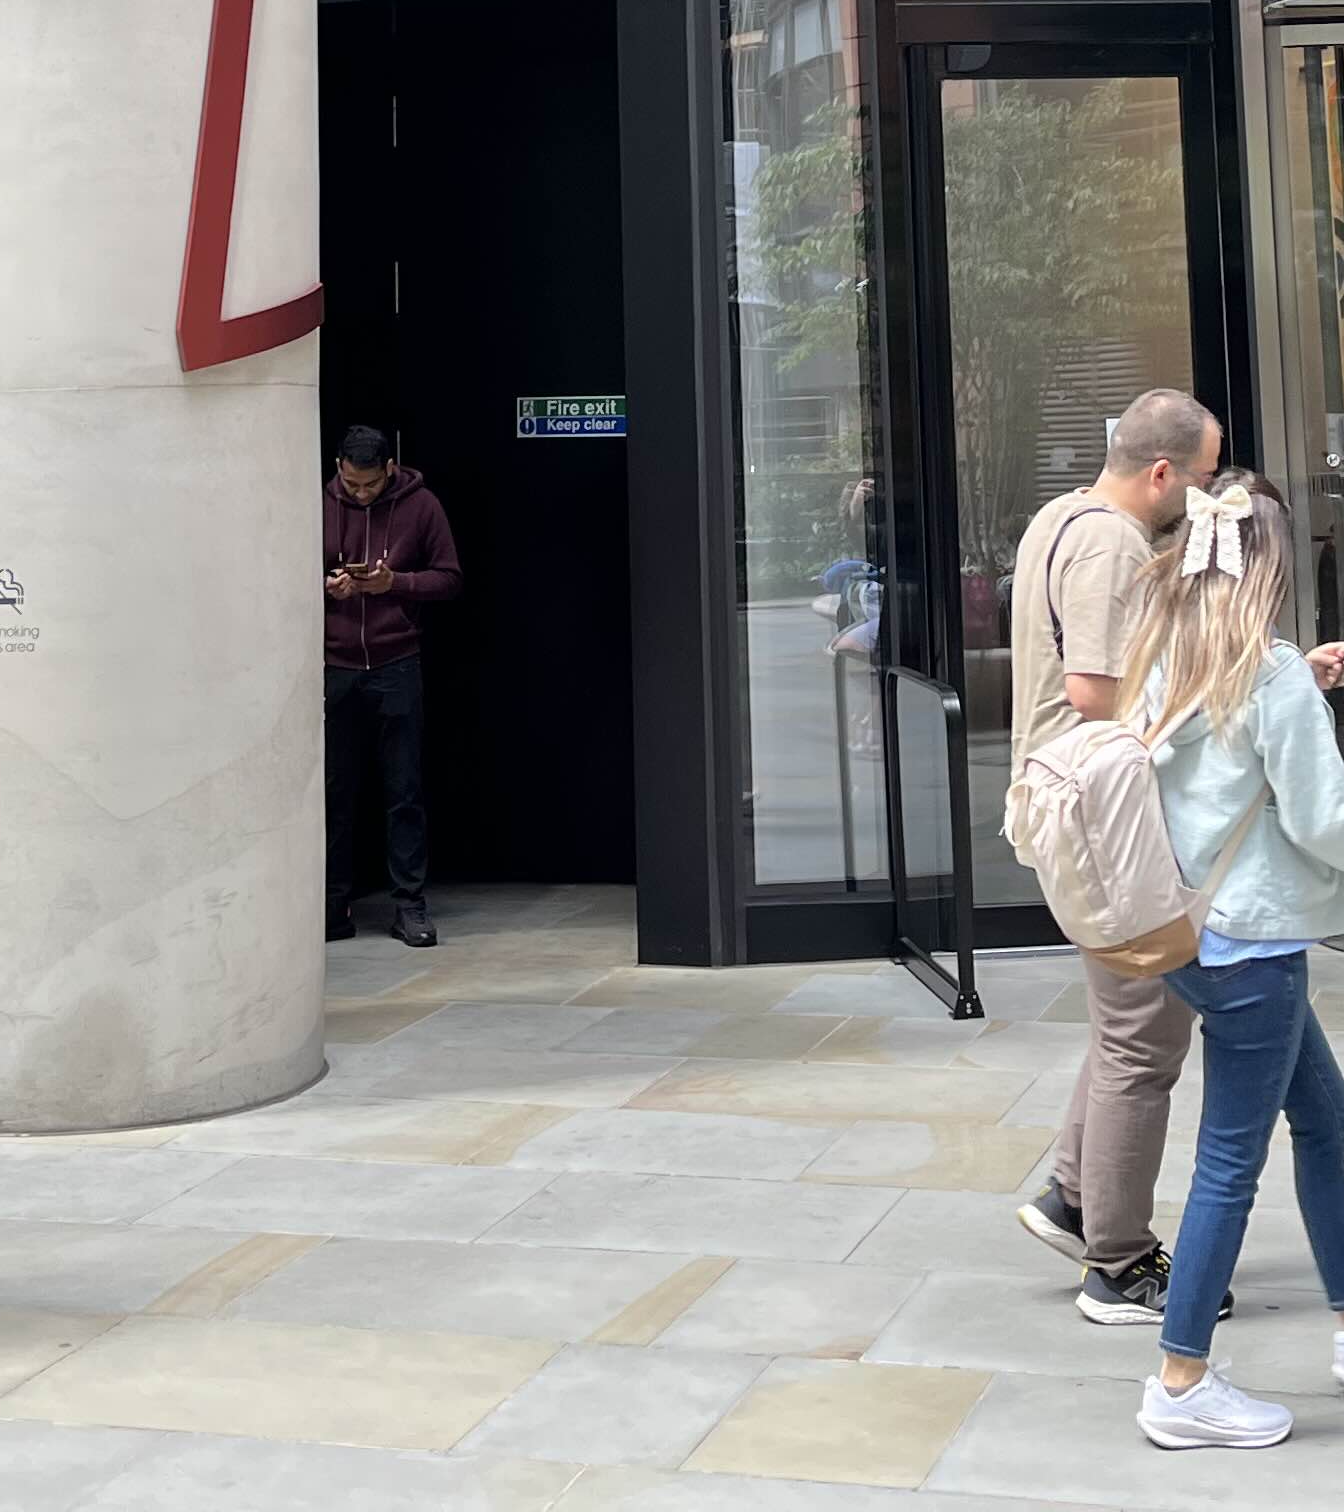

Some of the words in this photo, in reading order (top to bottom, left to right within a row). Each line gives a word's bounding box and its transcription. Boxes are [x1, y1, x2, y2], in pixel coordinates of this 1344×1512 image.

[546, 400, 580, 415] Fire
[584, 399, 617, 415] exit
[546, 418, 580, 433] Keep
[584, 418, 617, 430] clear
[4, 643, 35, 653] area
